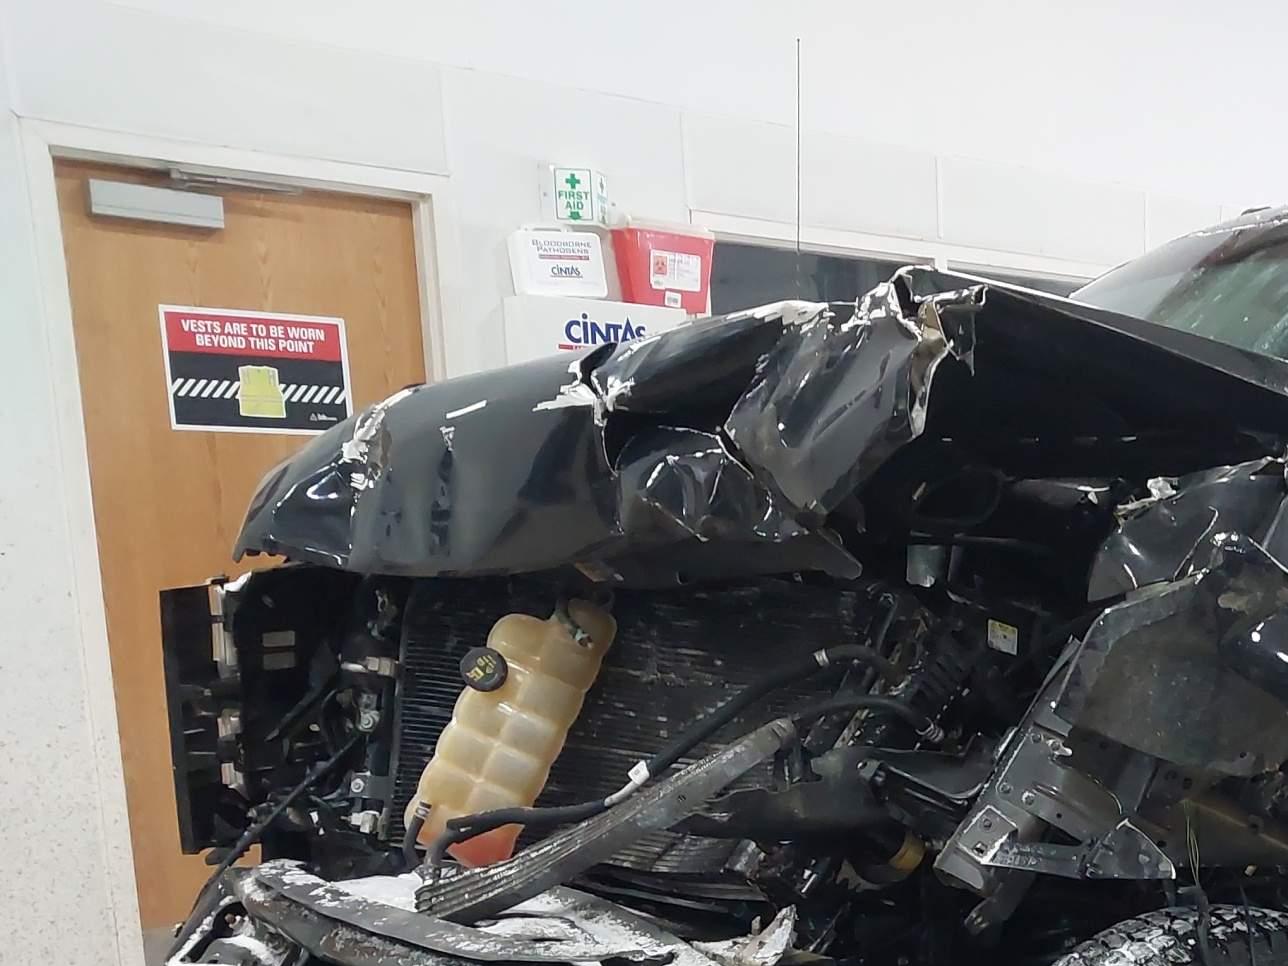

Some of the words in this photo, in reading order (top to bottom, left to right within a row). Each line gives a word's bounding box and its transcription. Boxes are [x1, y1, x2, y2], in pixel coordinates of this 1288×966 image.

[558, 191, 590, 200] FIRST
[565, 201, 584, 210] AID
[181, 319, 221, 333] VESTS
[224, 321, 248, 335] ARE
[250, 324, 266, 337] TO
[269, 326, 285, 338] BE
[287, 327, 325, 341] WORN
[196, 334, 246, 349] BEYOND
[248, 337, 276, 351] THIS
[279, 339, 314, 353] POINT
